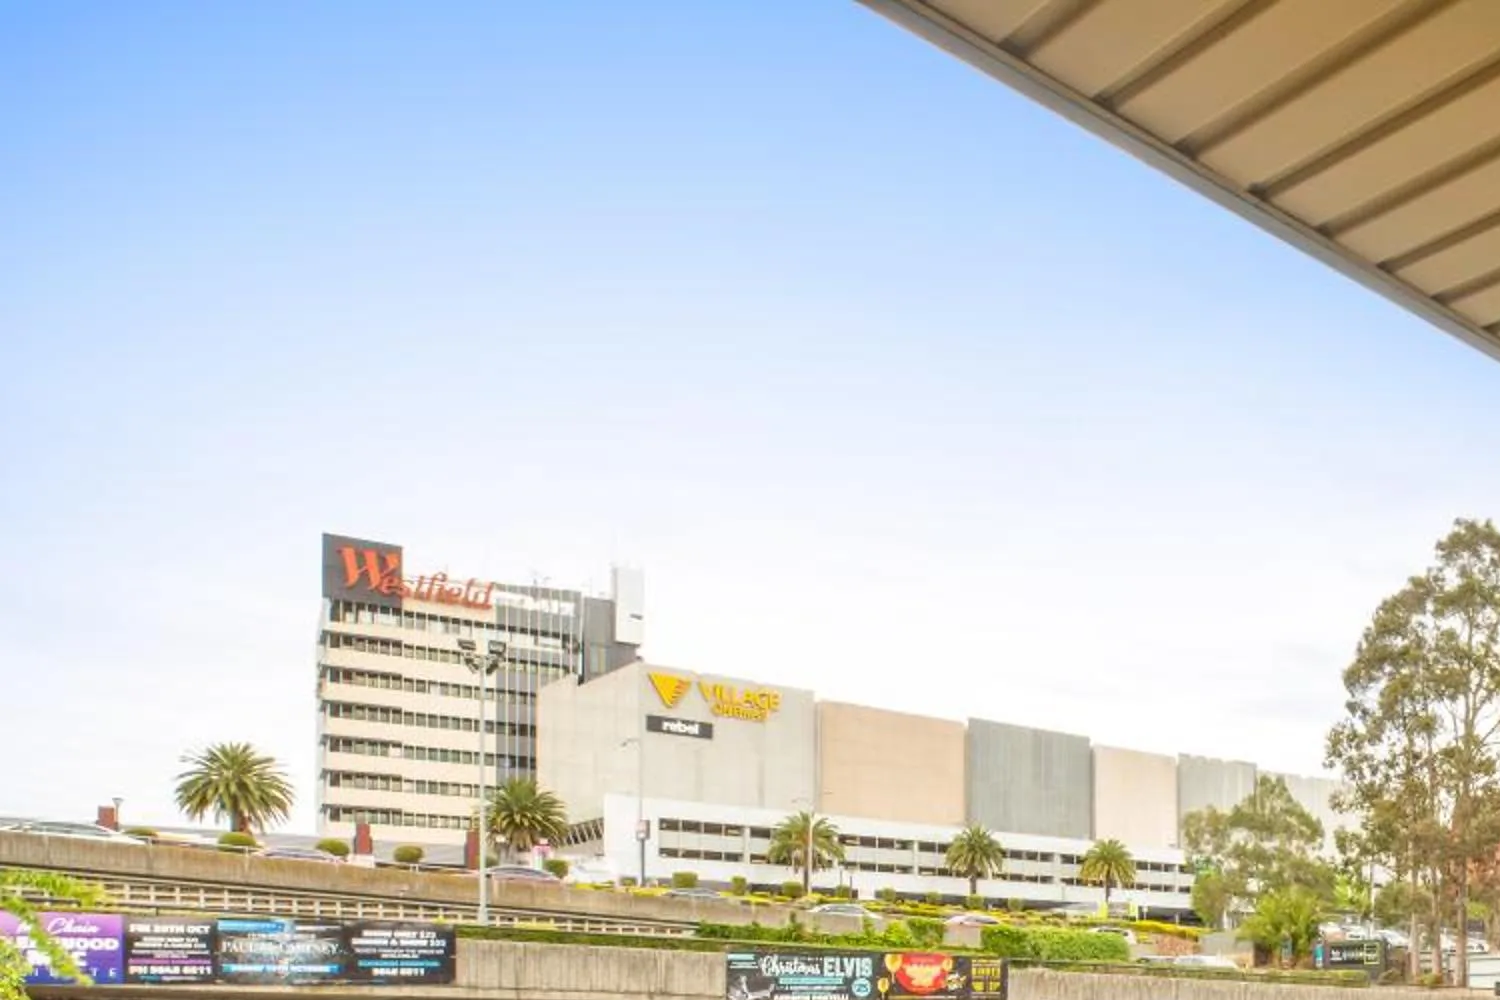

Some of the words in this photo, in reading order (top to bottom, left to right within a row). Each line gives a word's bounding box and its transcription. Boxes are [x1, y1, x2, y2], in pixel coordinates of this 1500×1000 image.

[336, 545, 493, 610] Westfield
[662, 720, 700, 735] rebel
[760, 954, 821, 977] Christmas
[823, 955, 873, 977] ELVIS
